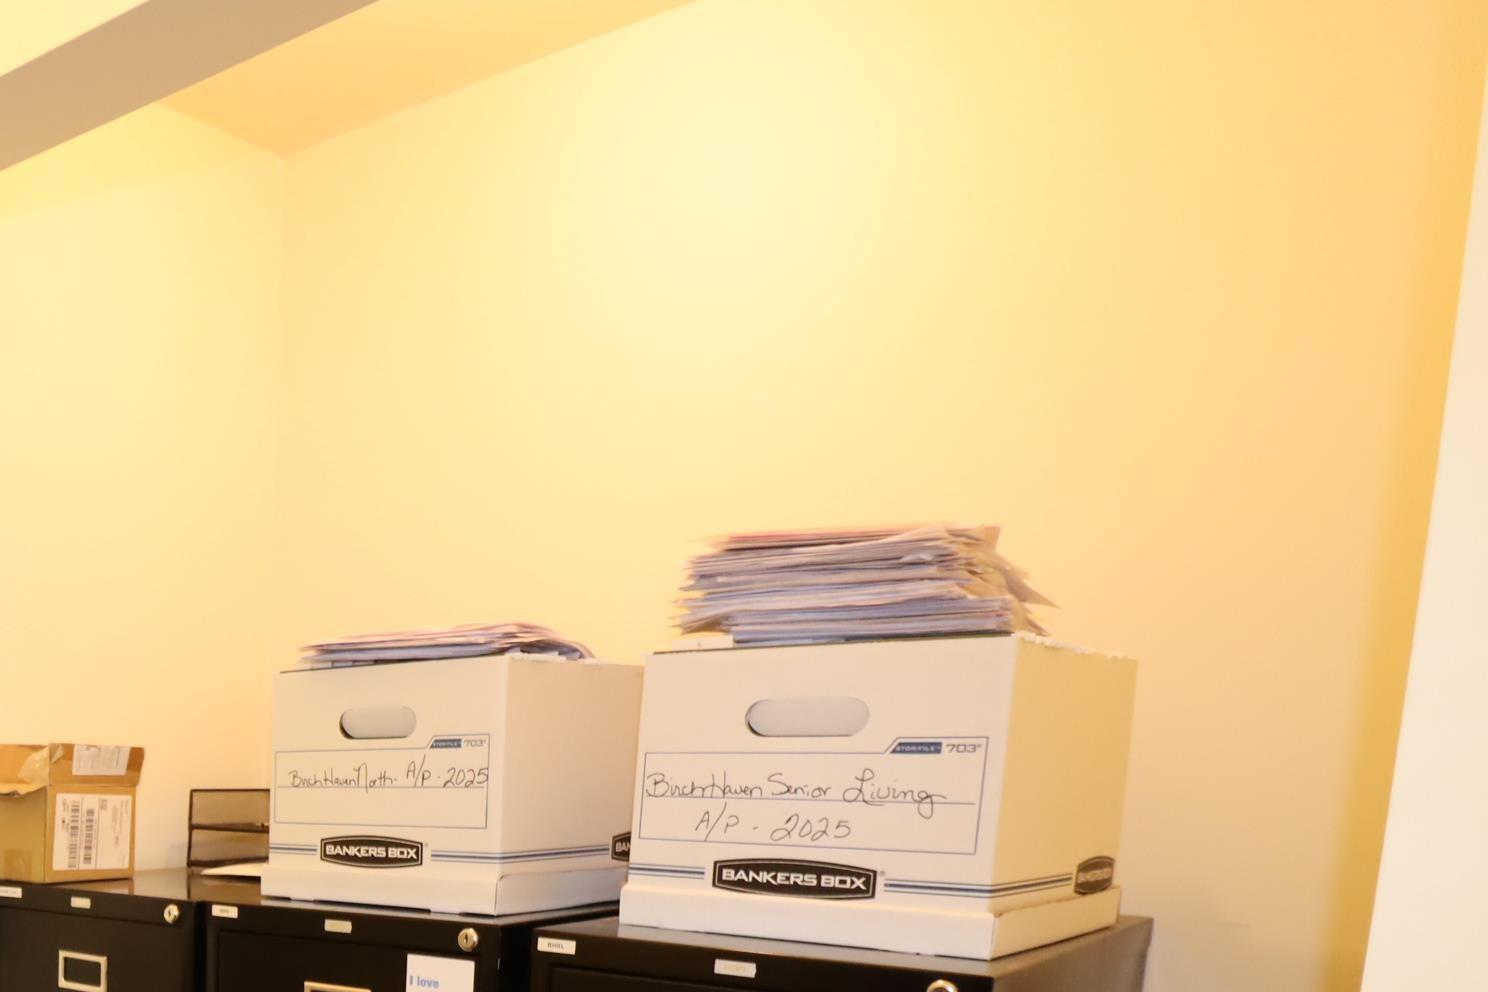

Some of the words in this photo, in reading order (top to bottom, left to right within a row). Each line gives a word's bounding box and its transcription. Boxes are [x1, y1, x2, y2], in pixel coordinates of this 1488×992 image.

[443, 767, 488, 788] 2025
[768, 773, 832, 797] Senior
[843, 768, 947, 819] Living
[770, 813, 852, 841] 2025
[325, 844, 386, 858] BANKERS
[388, 847, 417, 859] BOX
[721, 868, 818, 888] BANKERS
[821, 872, 867, 891] BOX
[417, 976, 439, 989] love
